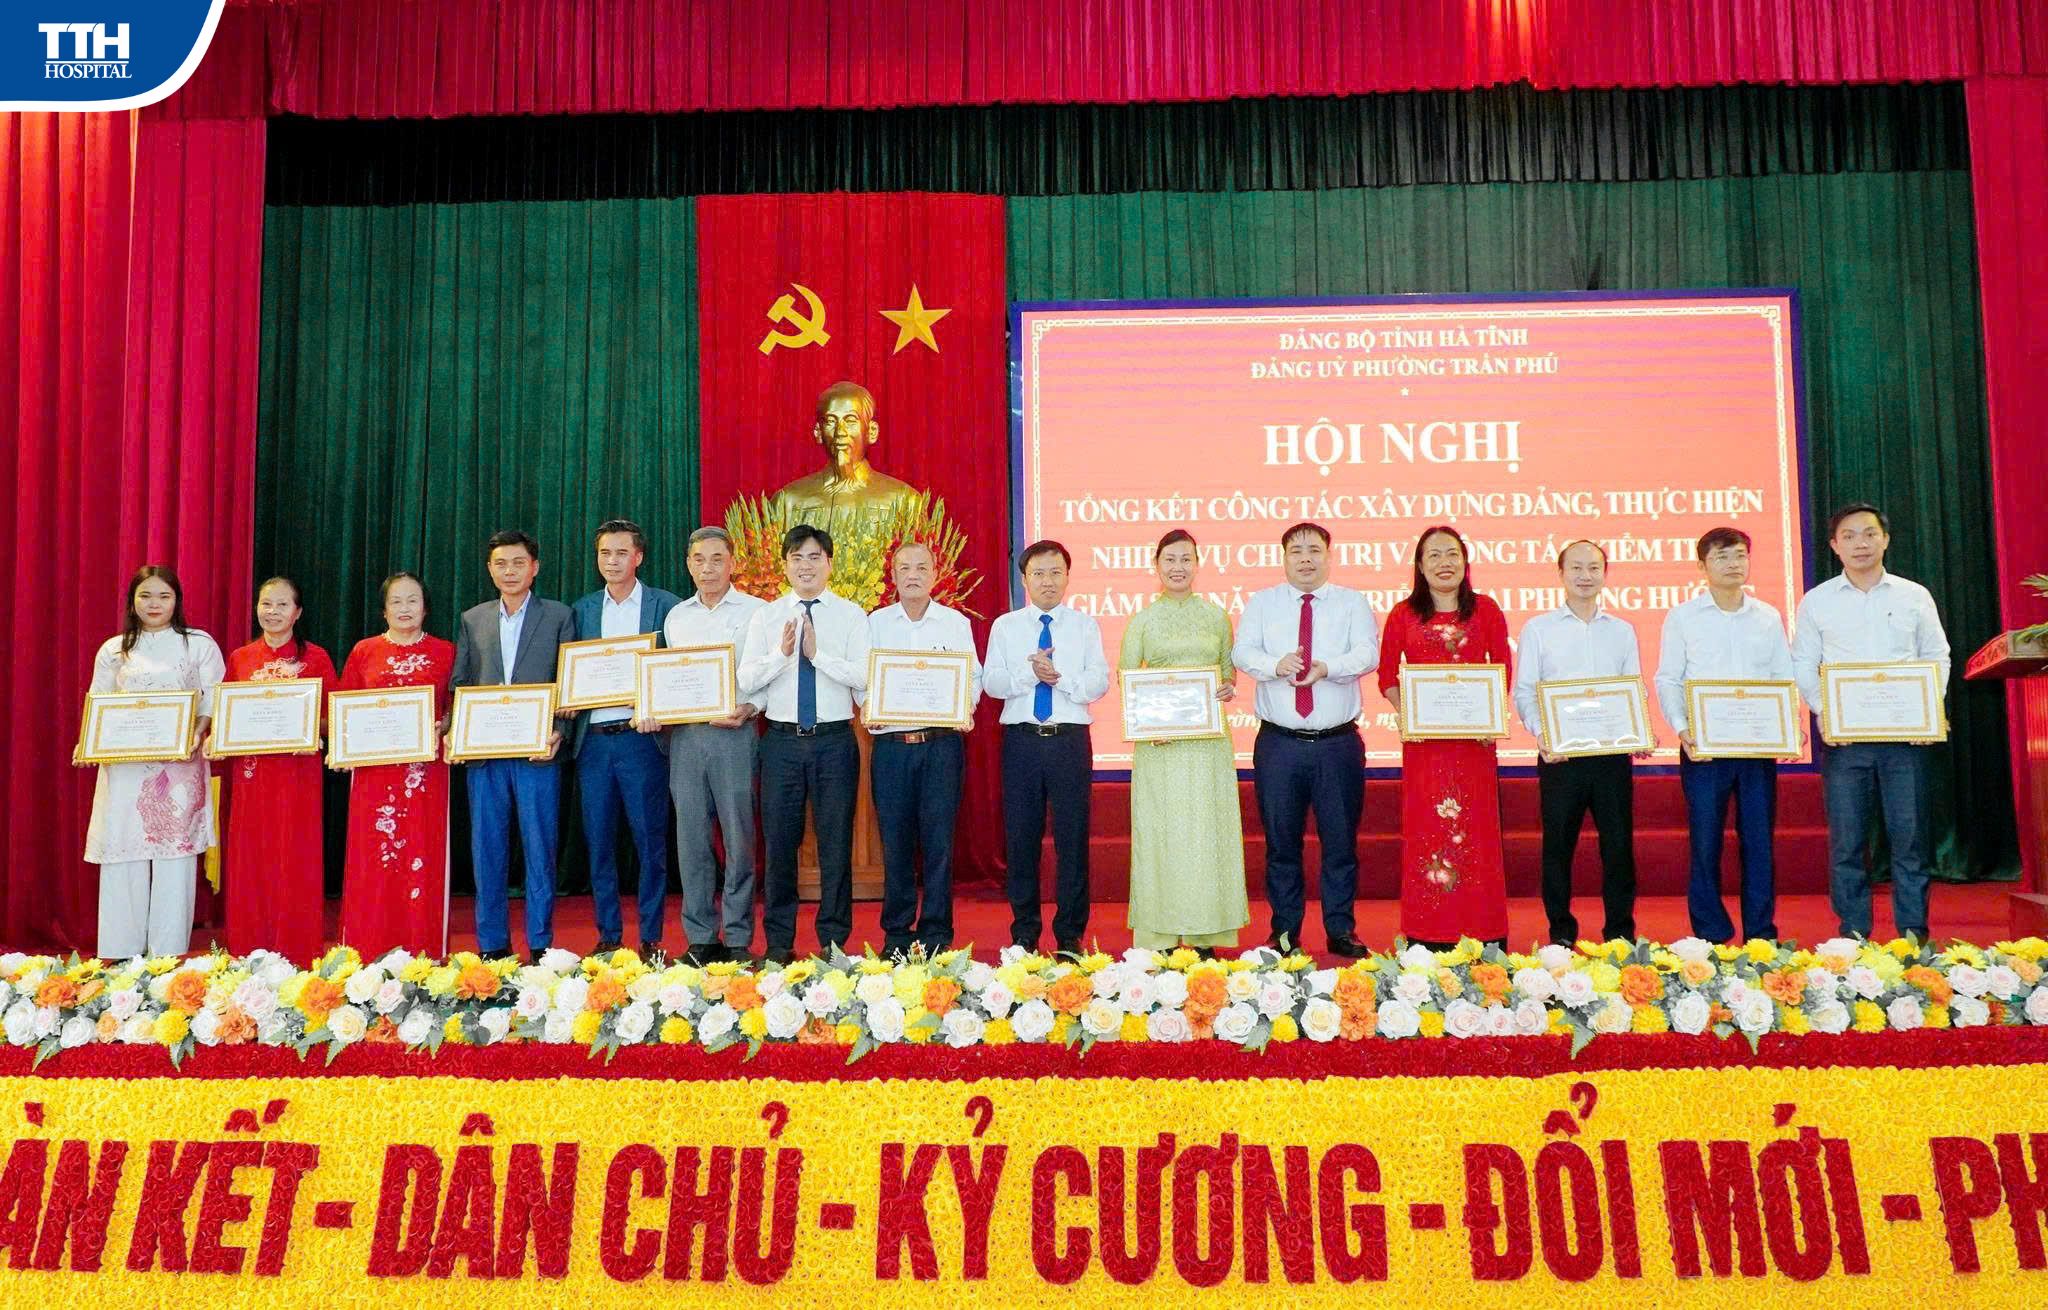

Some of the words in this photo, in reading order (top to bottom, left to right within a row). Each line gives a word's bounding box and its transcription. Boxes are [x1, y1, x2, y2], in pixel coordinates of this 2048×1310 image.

[1280, 328, 1340, 349] ĐẢNG
[1346, 329, 1375, 353] BỘ
[1380, 326, 1433, 347] TỈNH
[1440, 325, 1470, 346] HÀ
[1475, 325, 1527, 345] TĨNH
[1252, 357, 1312, 378] ĐẢNG
[1318, 355, 1347, 377] UỶ
[1353, 352, 1445, 376] PHƯỜNG
[1450, 353, 1508, 374] TRẦN
[1515, 352, 1557, 373] PHÚ
[1264, 417, 1365, 476] HỘI
[1379, 422, 1522, 473] NGHỊ
[1060, 493, 1140, 522] TỔNG
[1146, 492, 1203, 521] KẾT
[1208, 491, 1290, 520] CÔNG
[1295, 490, 1352, 519] TÁC
[1359, 488, 1417, 518] XÂY
[1424, 491, 1502, 522] DỰNG
[1512, 486, 1600, 518] ĐẢNG,
[1604, 487, 1686, 520] THỰC
[1693, 487, 1762, 518] HIỆN
[1092, 542, 1156, 574] NHIỆ
[1335, 543, 1383, 571] TRỊ
[125, 1099, 320, 1275] KẾT
[368, 1114, 578, 1280] DÂN
[601, 1102, 800, 1285] CHỦ
[876, 1096, 1006, 1280] KỶ
[1032, 1133, 1387, 1287] CƯƠNG
[1462, 1081, 1642, 1282] ĐỔI
[1659, 1104, 1870, 1281] MỚI
